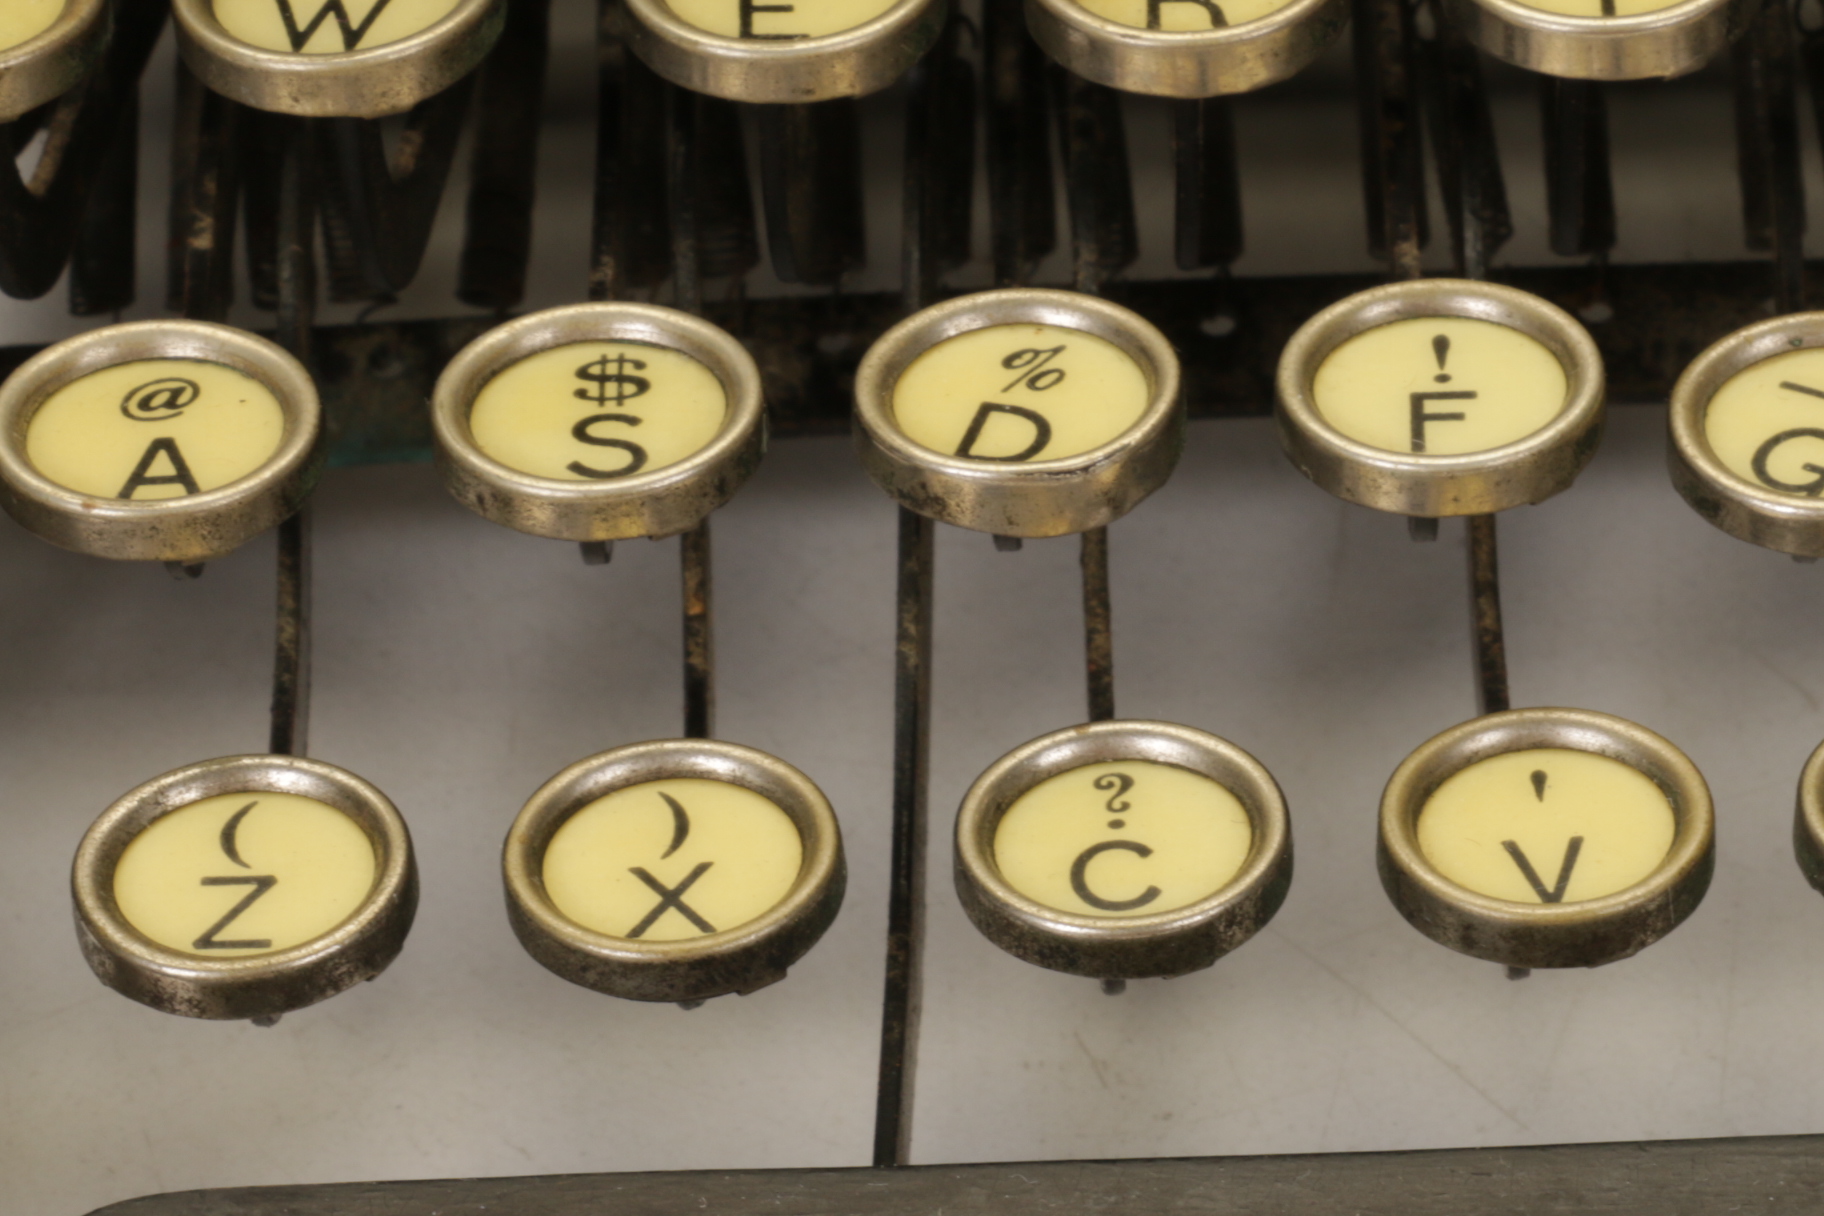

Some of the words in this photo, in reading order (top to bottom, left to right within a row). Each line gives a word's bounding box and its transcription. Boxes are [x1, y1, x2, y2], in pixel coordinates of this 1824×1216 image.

[275, 0, 392, 53] W
[572, 352, 651, 407] $
[1001, 344, 1067, 394] %
[1431, 334, 1453, 384] !
[119, 376, 201, 423] @
[1409, 390, 1478, 454] F
[566, 412, 649, 481] S
[953, 401, 1053, 463] D
[117, 436, 202, 501] A
[658, 791, 691, 859] )
[1093, 772, 1136, 831] ?
[219, 801, 259, 868] (
[624, 862, 717, 940] X
[1069, 839, 1162, 912] C
[1501, 836, 1584, 904] V
[191, 874, 278, 951] Z
